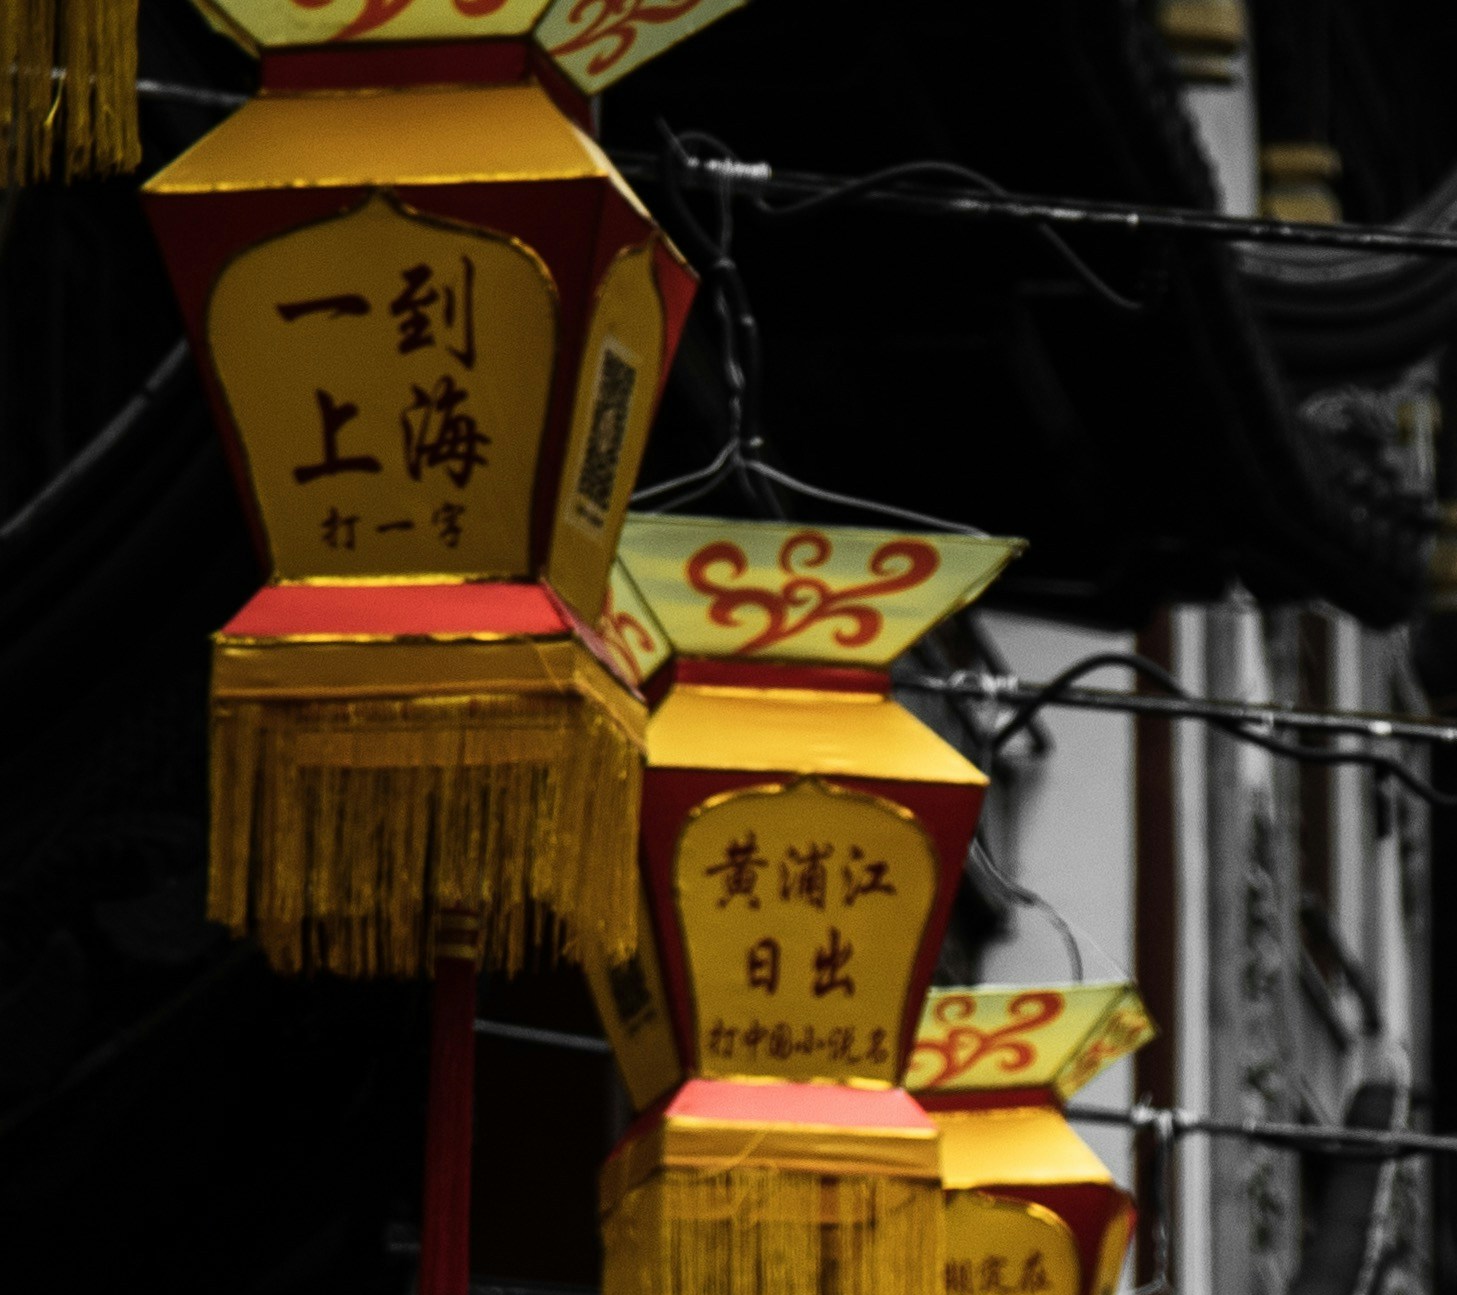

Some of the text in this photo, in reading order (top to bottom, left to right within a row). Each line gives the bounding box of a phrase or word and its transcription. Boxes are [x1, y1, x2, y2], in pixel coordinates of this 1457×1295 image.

[276, 255, 476, 368] 一到
[293, 377, 491, 488] 上海
[321, 503, 467, 552] 打一字
[706, 831, 897, 909] 黄浦江
[747, 925, 855, 997] 日出
